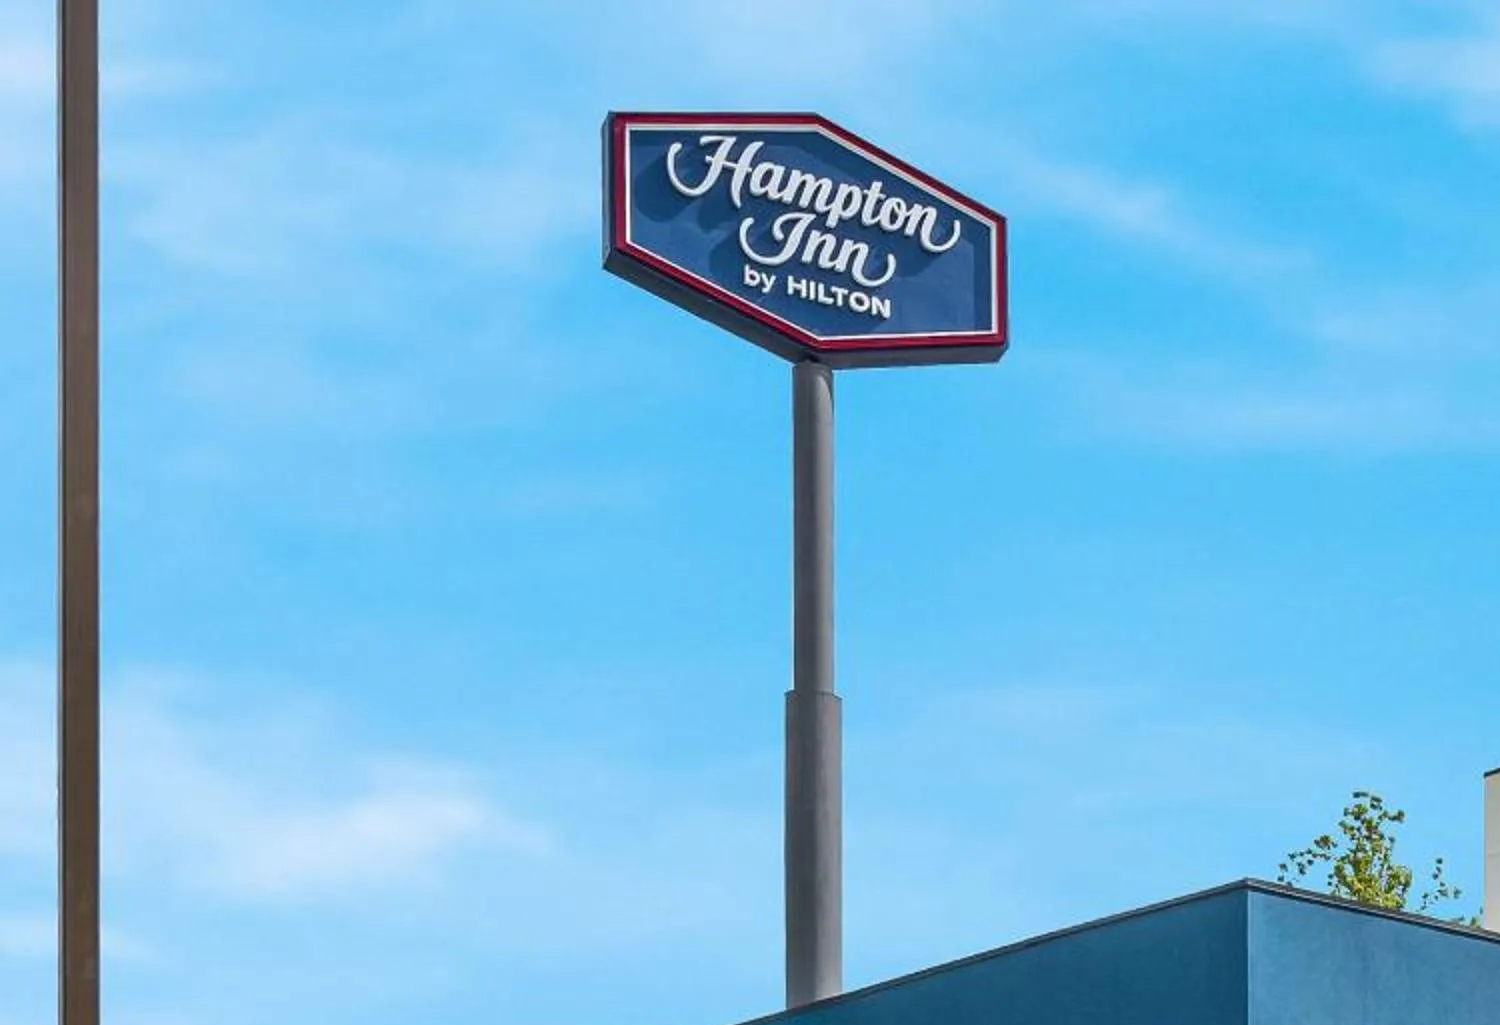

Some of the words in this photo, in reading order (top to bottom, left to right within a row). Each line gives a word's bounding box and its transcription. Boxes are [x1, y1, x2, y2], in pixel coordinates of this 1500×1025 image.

[667, 134, 961, 253] Hampton
[739, 212, 896, 287] Inn
[743, 264, 776, 294] by
[787, 275, 891, 319] HILTON
